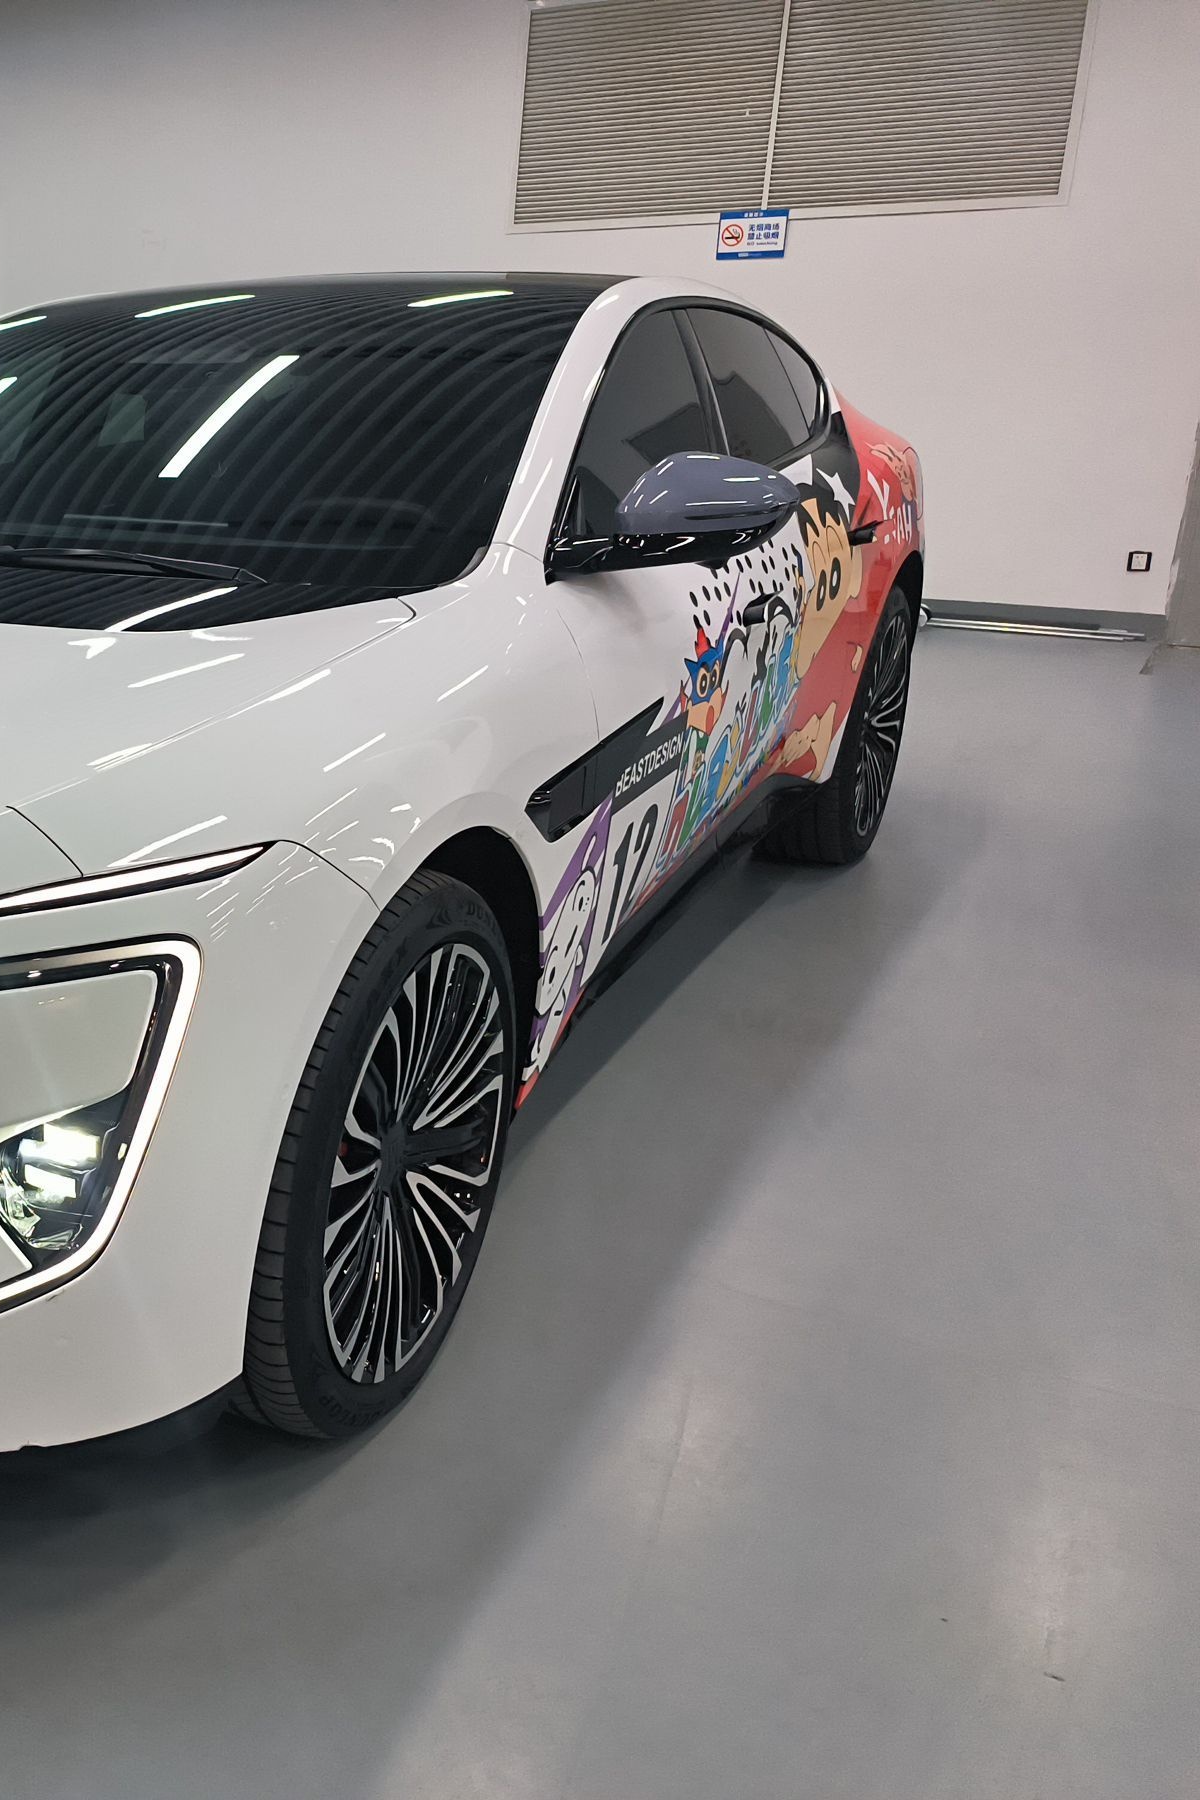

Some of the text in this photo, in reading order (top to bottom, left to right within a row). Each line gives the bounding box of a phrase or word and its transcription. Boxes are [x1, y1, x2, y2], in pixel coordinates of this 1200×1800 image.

[747, 231, 780, 240] 禁止吸烟
[615, 732, 684, 798] BEASTDESIGN
[601, 803, 659, 946] 12
